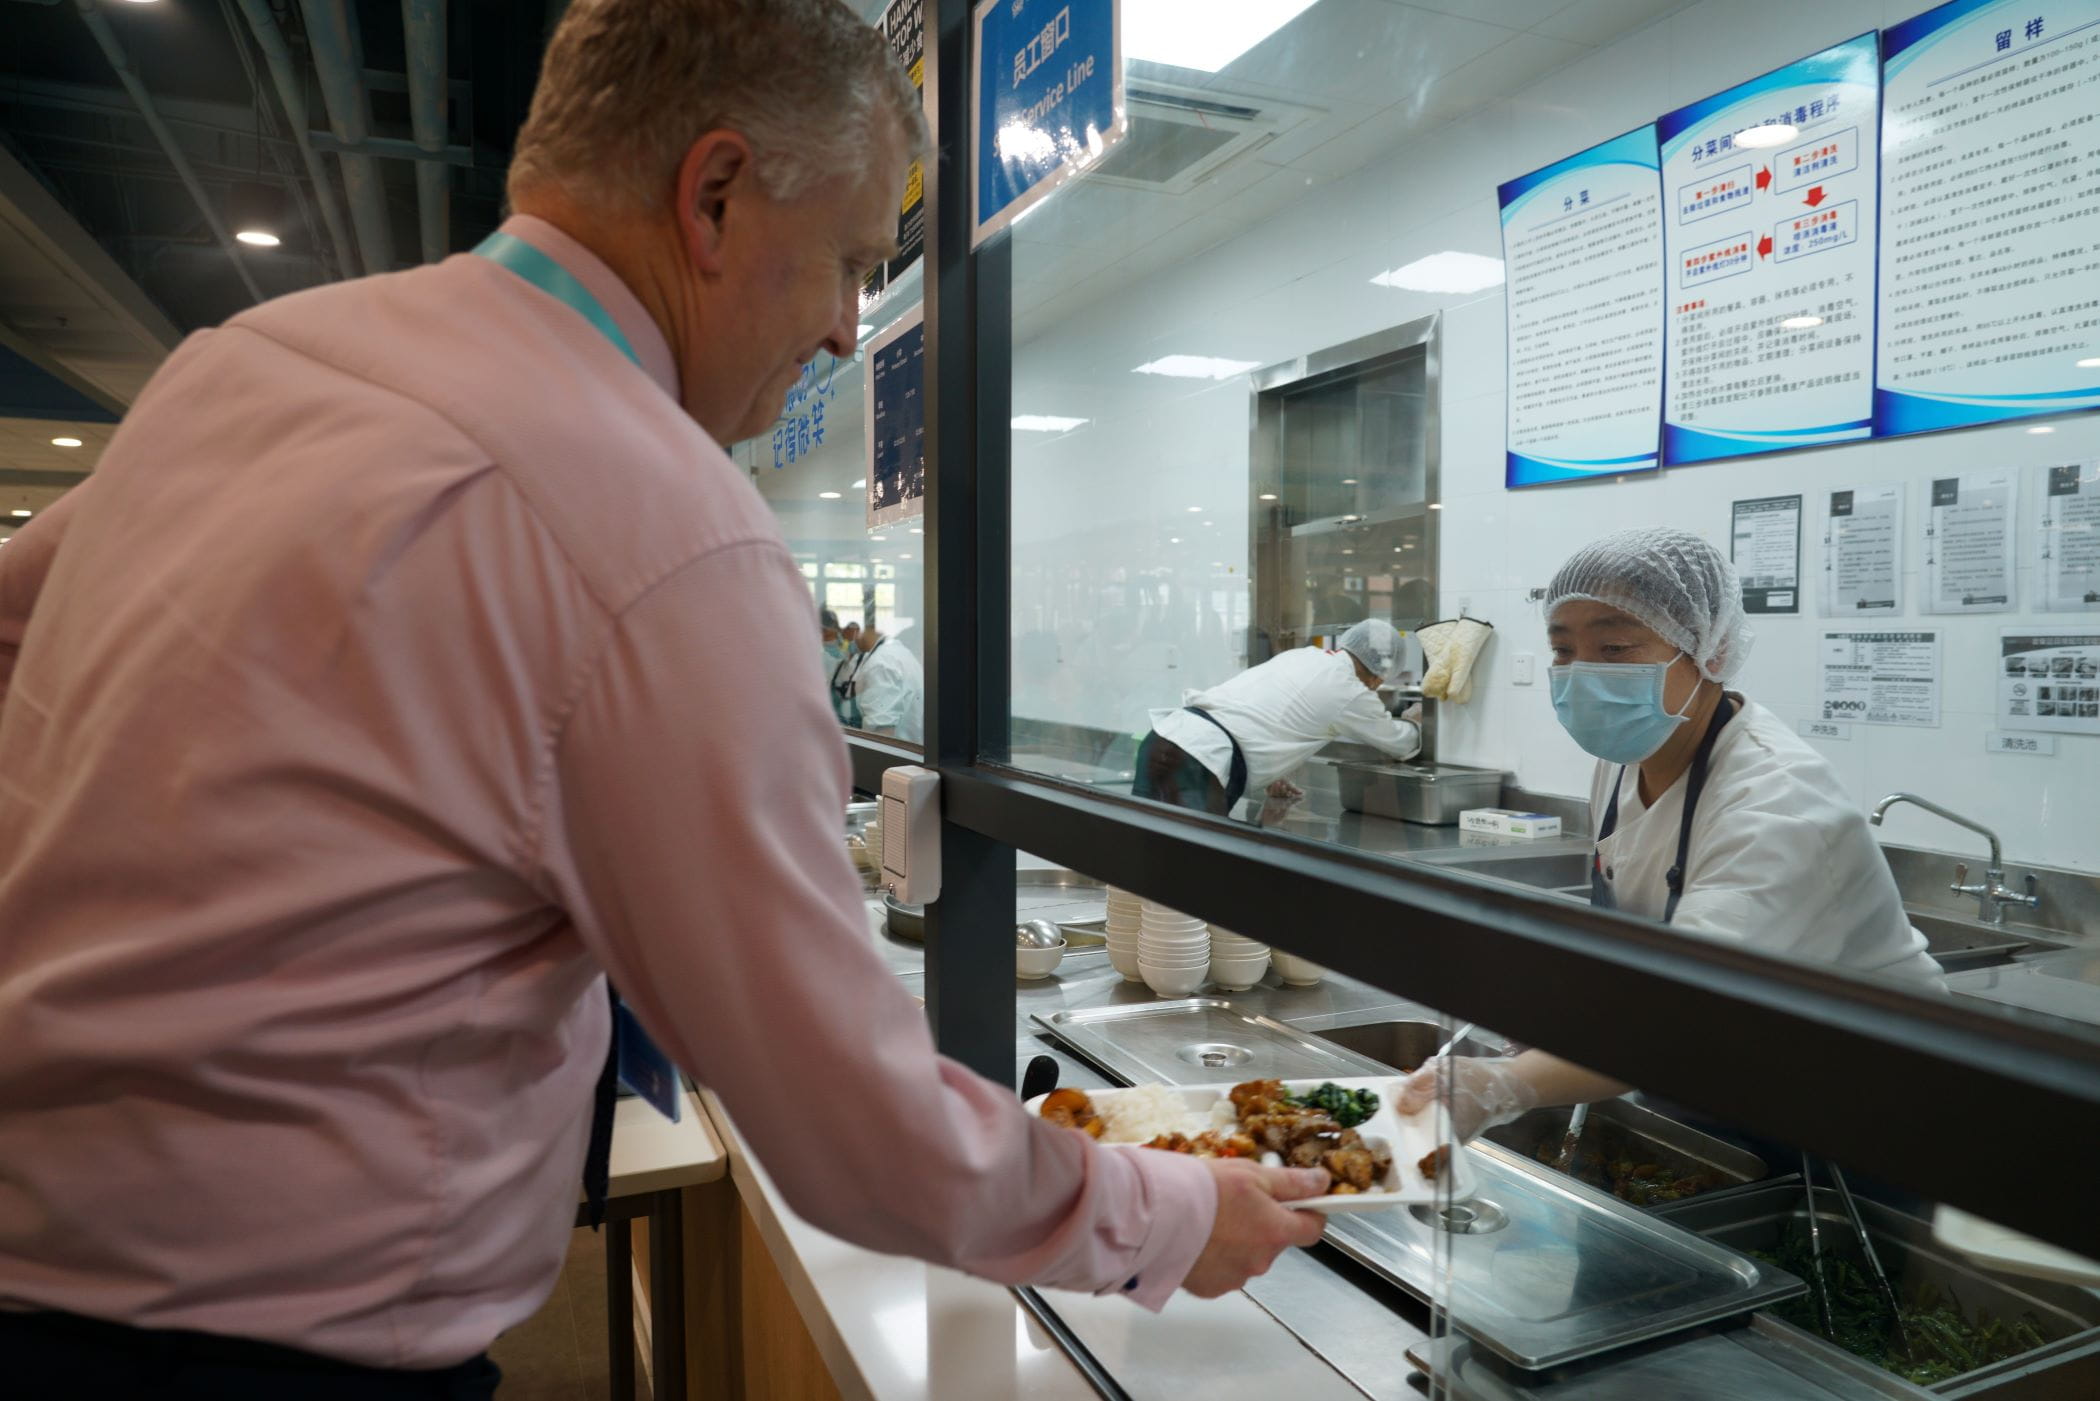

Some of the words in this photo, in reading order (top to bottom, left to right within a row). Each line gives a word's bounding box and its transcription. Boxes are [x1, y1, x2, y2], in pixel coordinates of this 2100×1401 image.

[1013, 5, 1070, 89] 员工窗口
[1067, 54, 1095, 94] Line
[773, 398, 825, 469] 记得微笑
